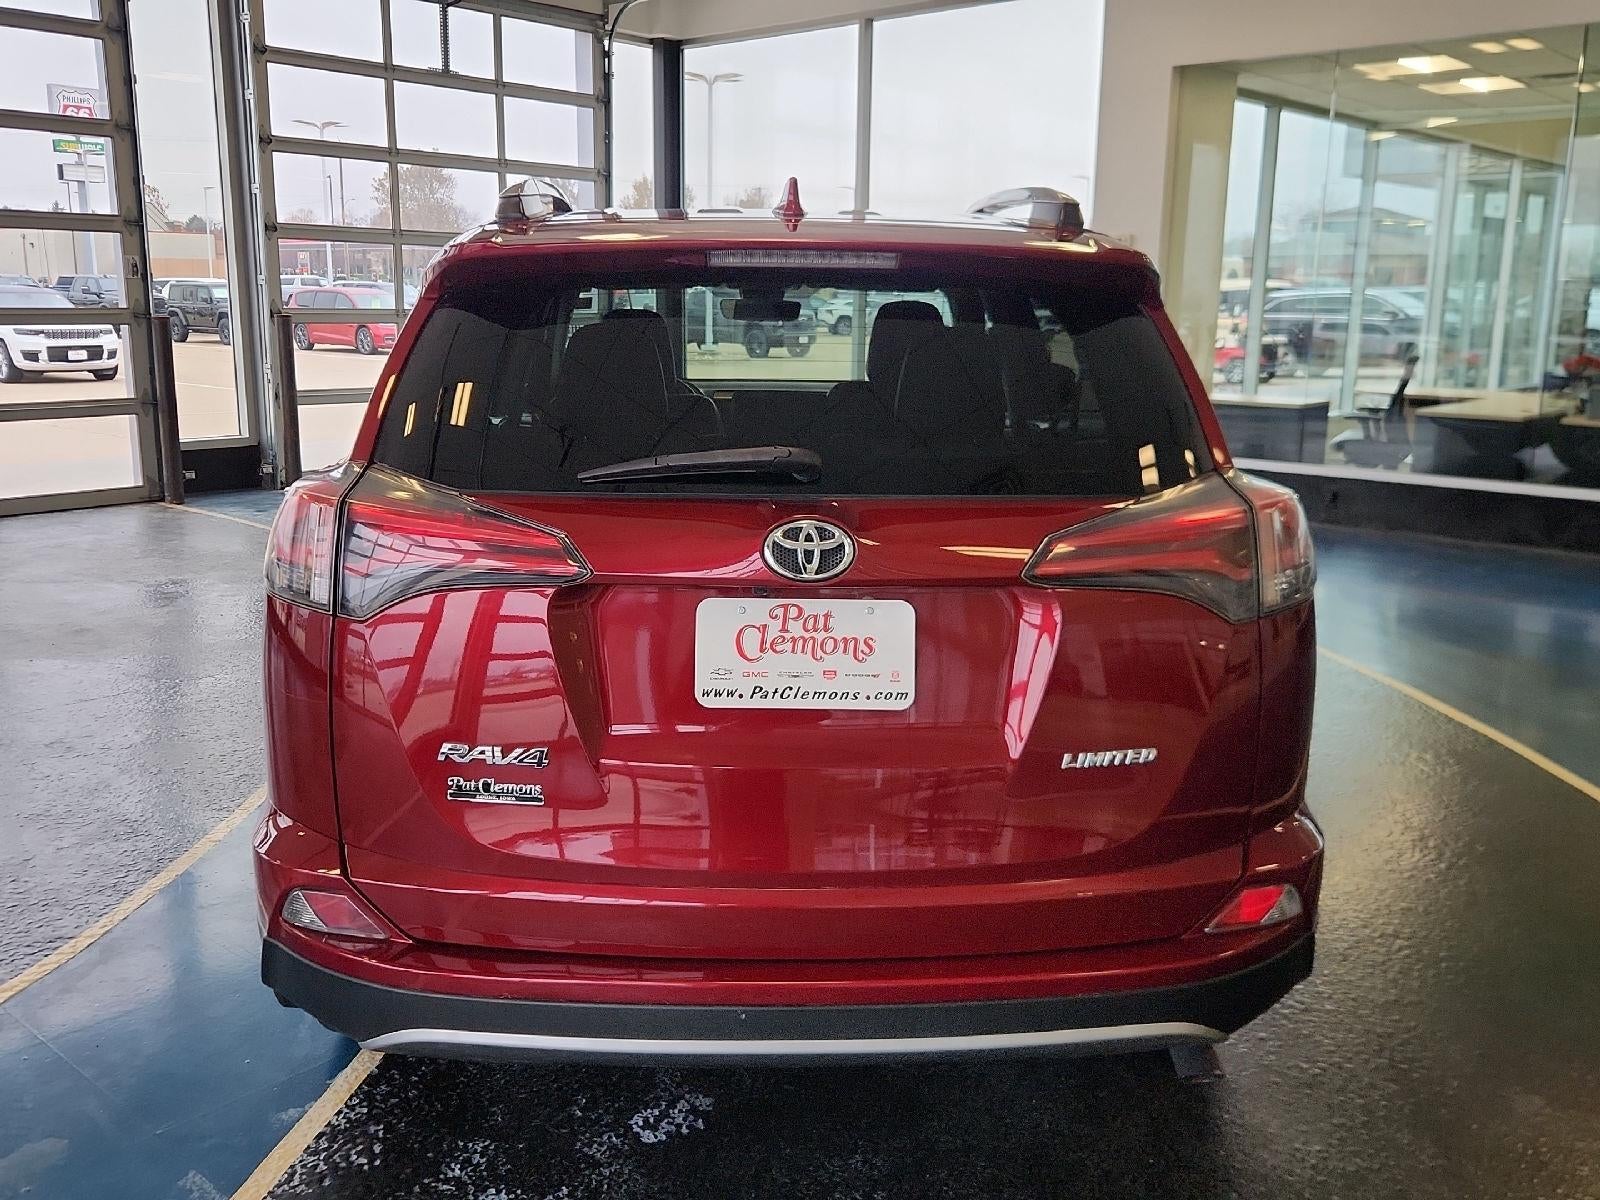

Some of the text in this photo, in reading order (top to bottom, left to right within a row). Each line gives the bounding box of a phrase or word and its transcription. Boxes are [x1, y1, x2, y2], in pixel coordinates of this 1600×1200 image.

[769, 602, 835, 634] Pat
[735, 623, 876, 664] Clemons
[437, 742, 550, 769] RAV4
[1060, 747, 1158, 770] LIMITED
[447, 776, 543, 797] Pat Clemons
